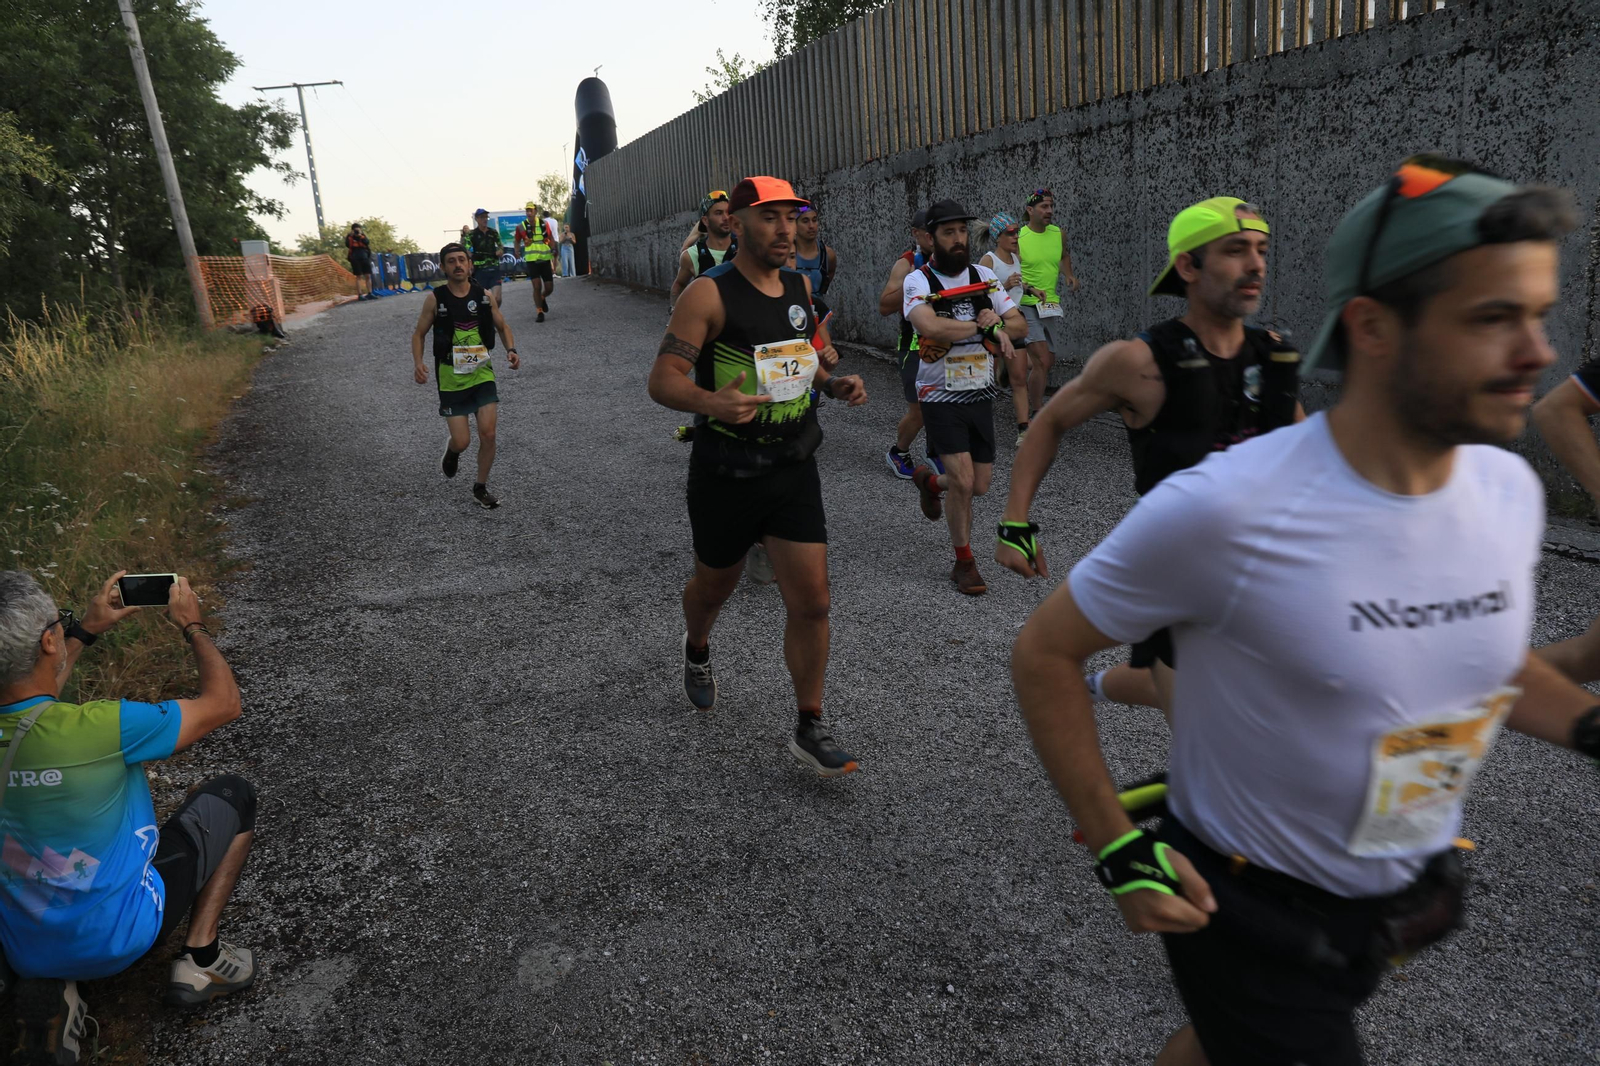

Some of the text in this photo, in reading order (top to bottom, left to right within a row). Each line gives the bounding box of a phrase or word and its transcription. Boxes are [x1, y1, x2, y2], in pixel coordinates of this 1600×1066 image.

[467, 355, 479, 363] 24
[782, 360, 800, 377] 12
[967, 365, 973, 376] 1
